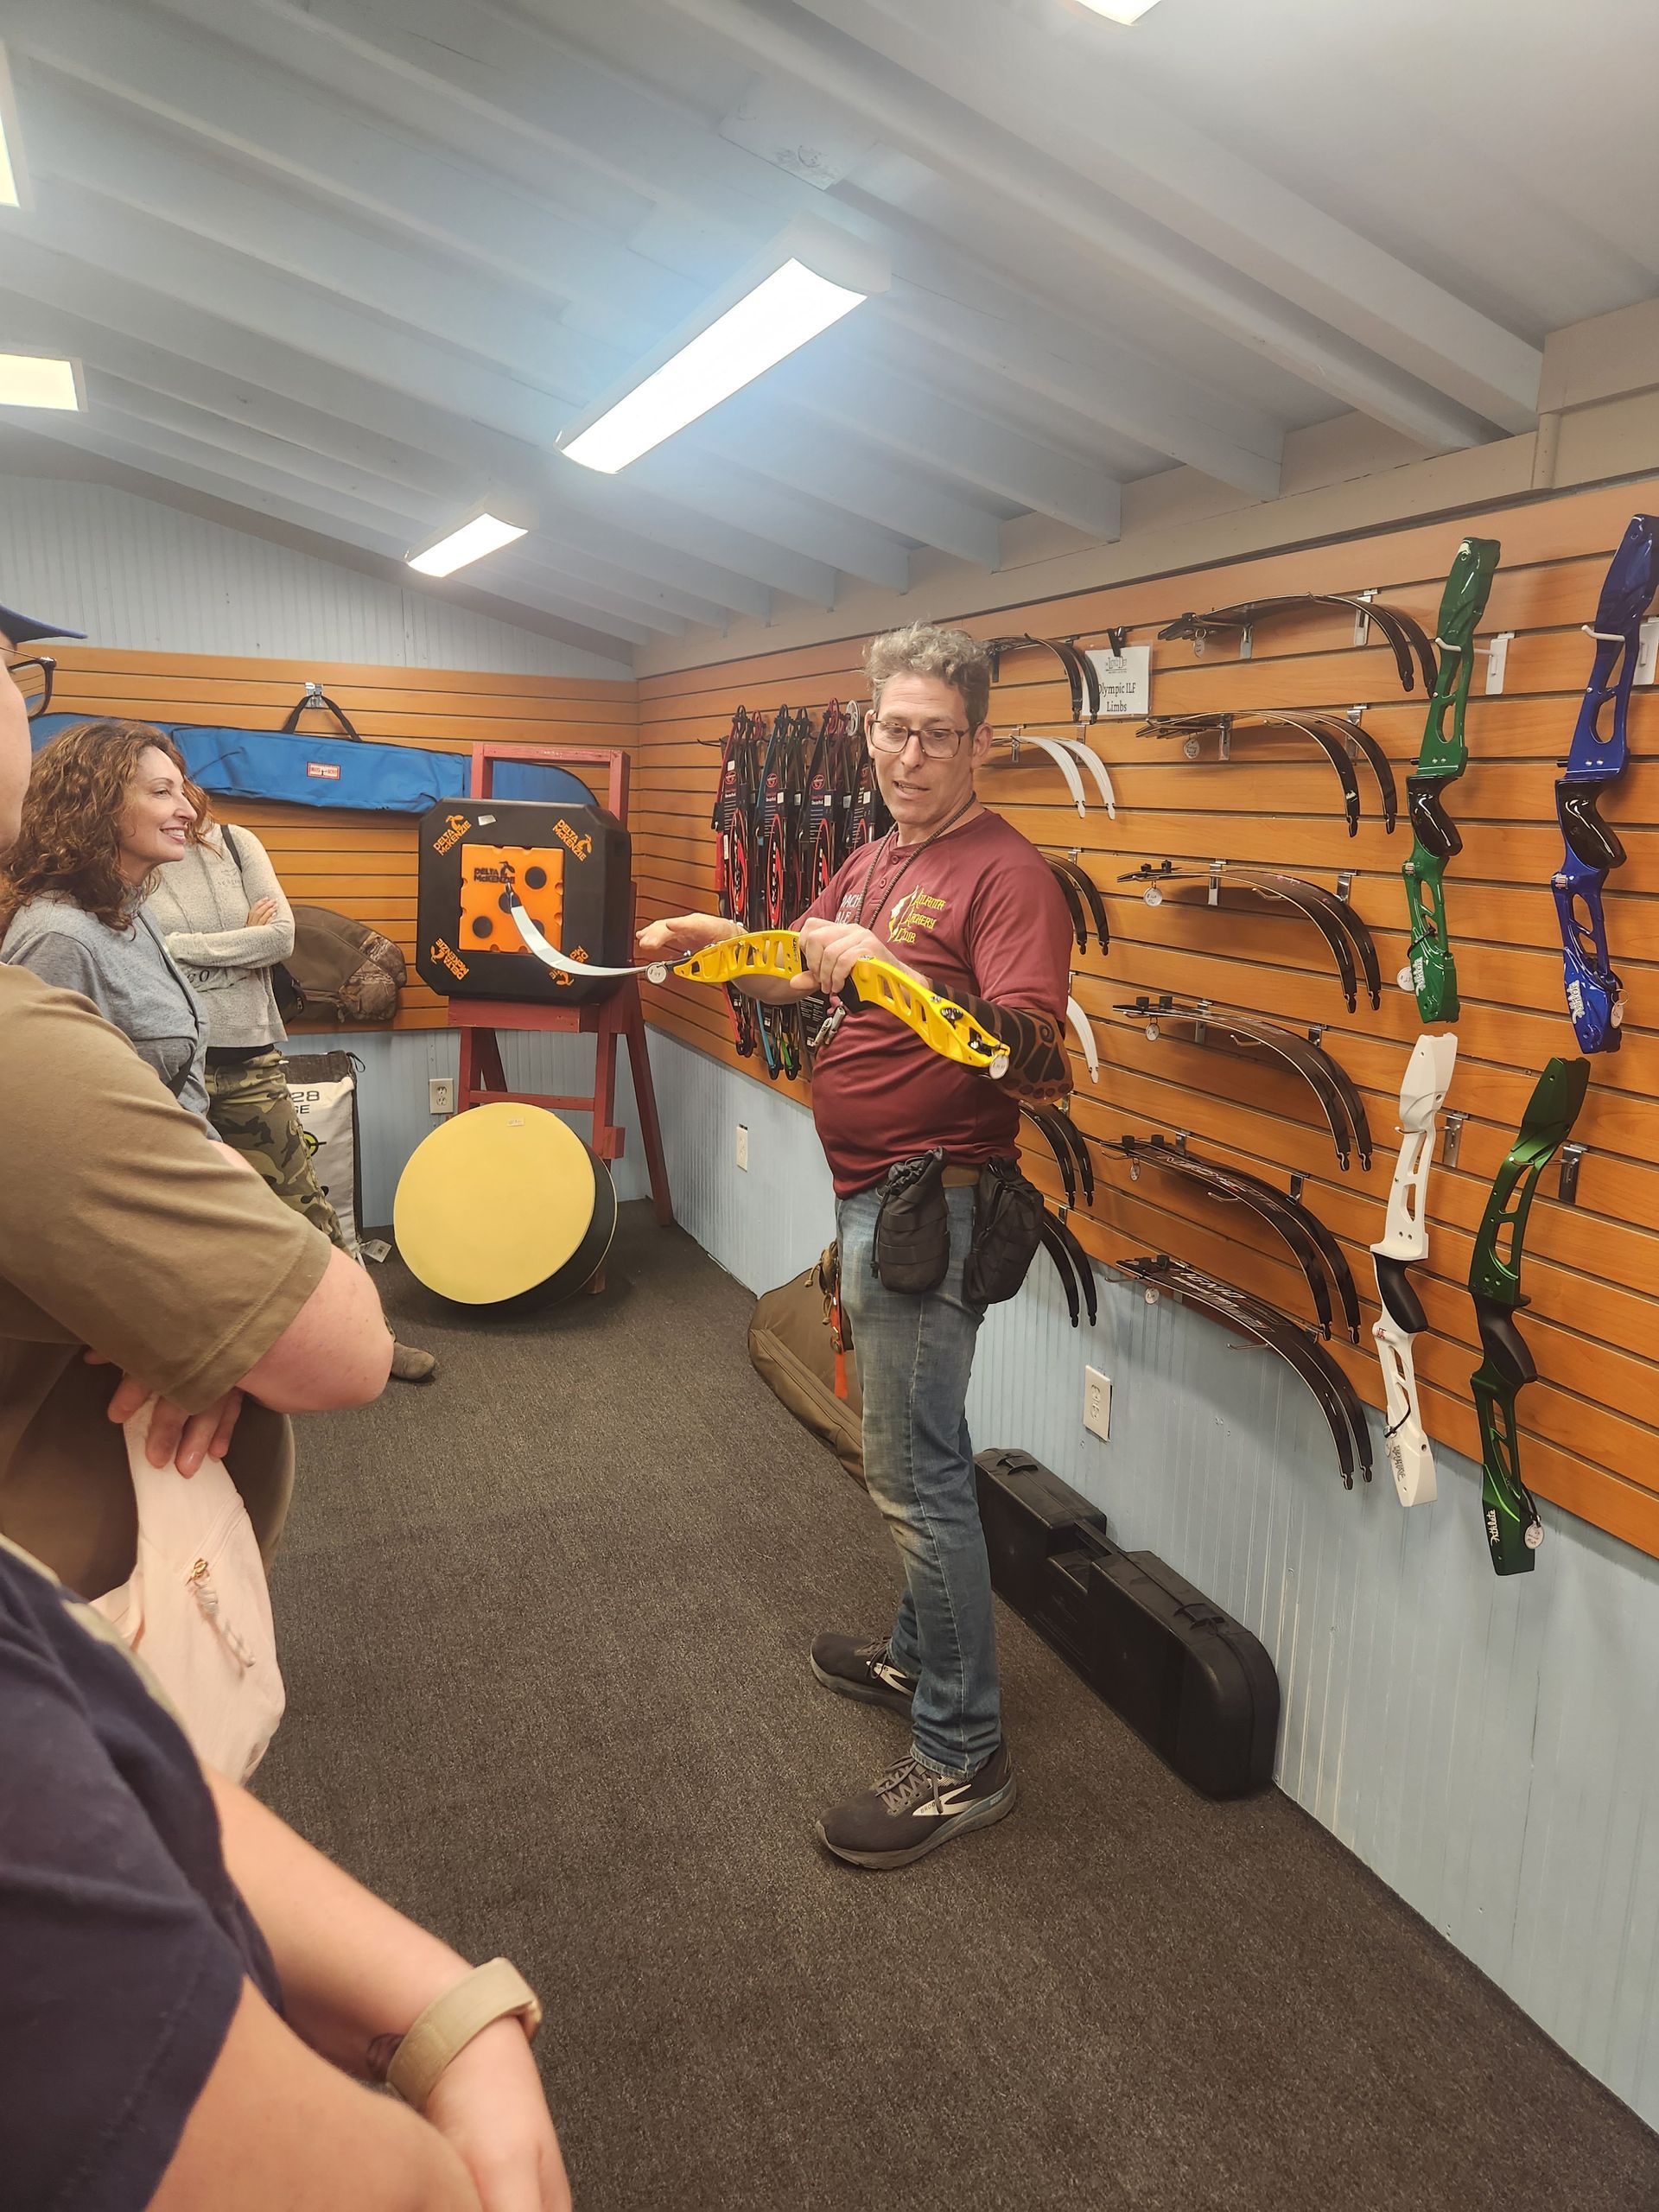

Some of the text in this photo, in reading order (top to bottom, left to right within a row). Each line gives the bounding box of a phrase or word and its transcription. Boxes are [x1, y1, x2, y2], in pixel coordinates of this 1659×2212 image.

[1098, 682, 1136, 698] Olympic ILF
[1106, 700, 1128, 712] Limbs
[433, 829, 455, 851] DELTA
[438, 820, 472, 856] McKENZIE
[552, 824, 587, 861] McKENZIE
[556, 818, 578, 844] DELTA
[474, 867, 499, 875] DELTA
[474, 874, 516, 884] McKENZIE
[435, 938, 470, 976] McKENZIE
[443, 954, 465, 981] DELTA
[1486, 1509, 1501, 1547] Athlete
[920, 1800, 942, 1815] BROO
